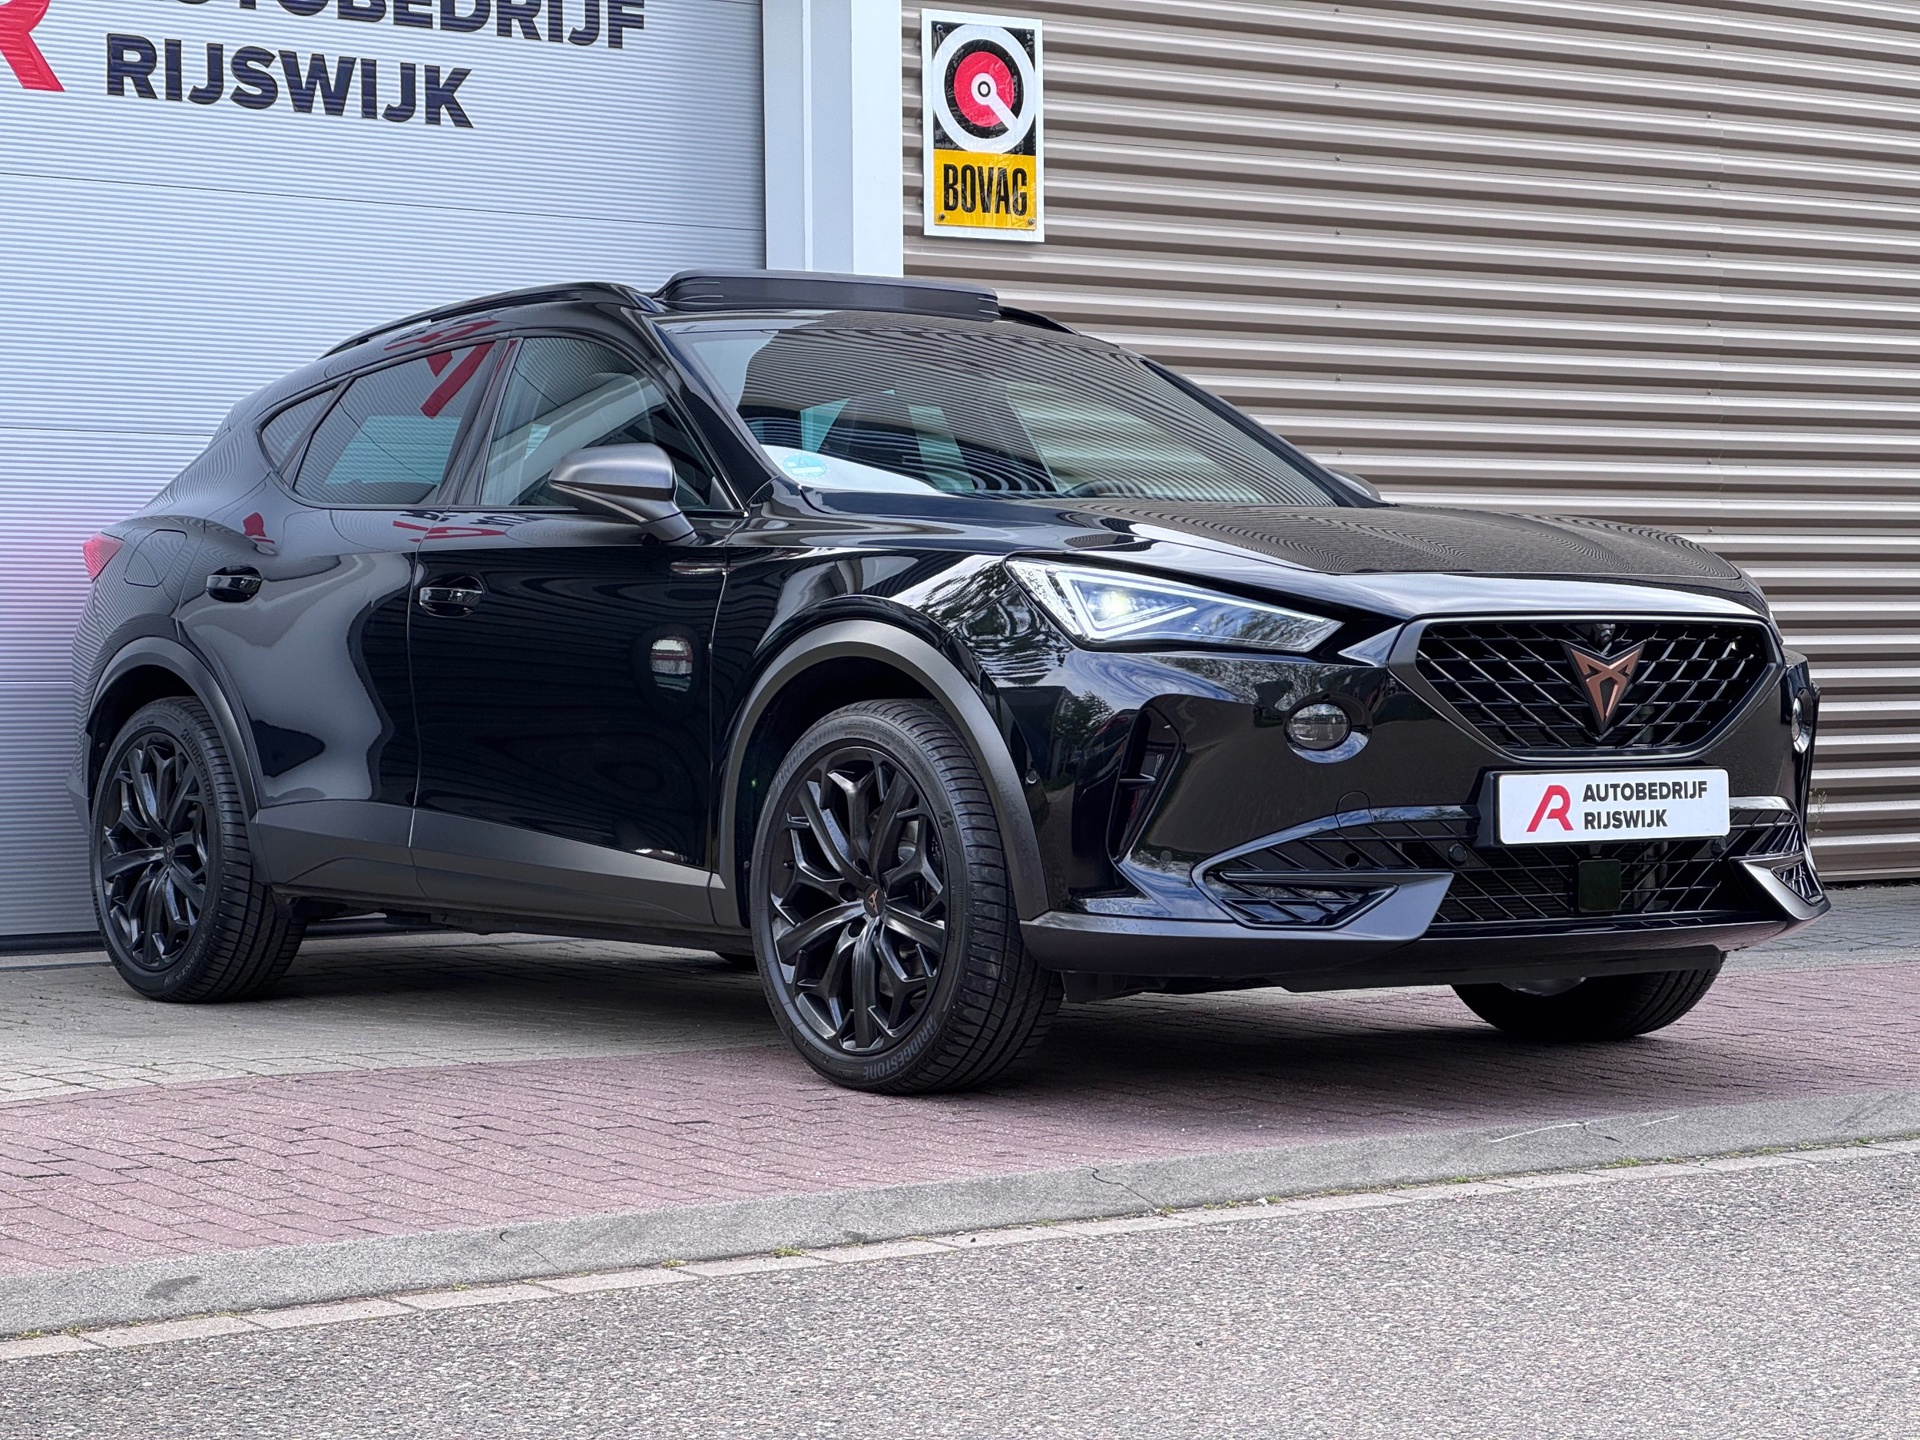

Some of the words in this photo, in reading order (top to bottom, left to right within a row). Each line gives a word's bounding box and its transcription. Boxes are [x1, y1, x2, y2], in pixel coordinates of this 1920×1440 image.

[107, 33, 473, 128] RIJSWIJK
[943, 164, 1027, 215] BOVAG
[1582, 781, 1708, 802] AUTOBEDRIJF
[1584, 809, 1668, 830] RIJSWIJK
[863, 1013, 938, 1080] BRIDGESTONE
